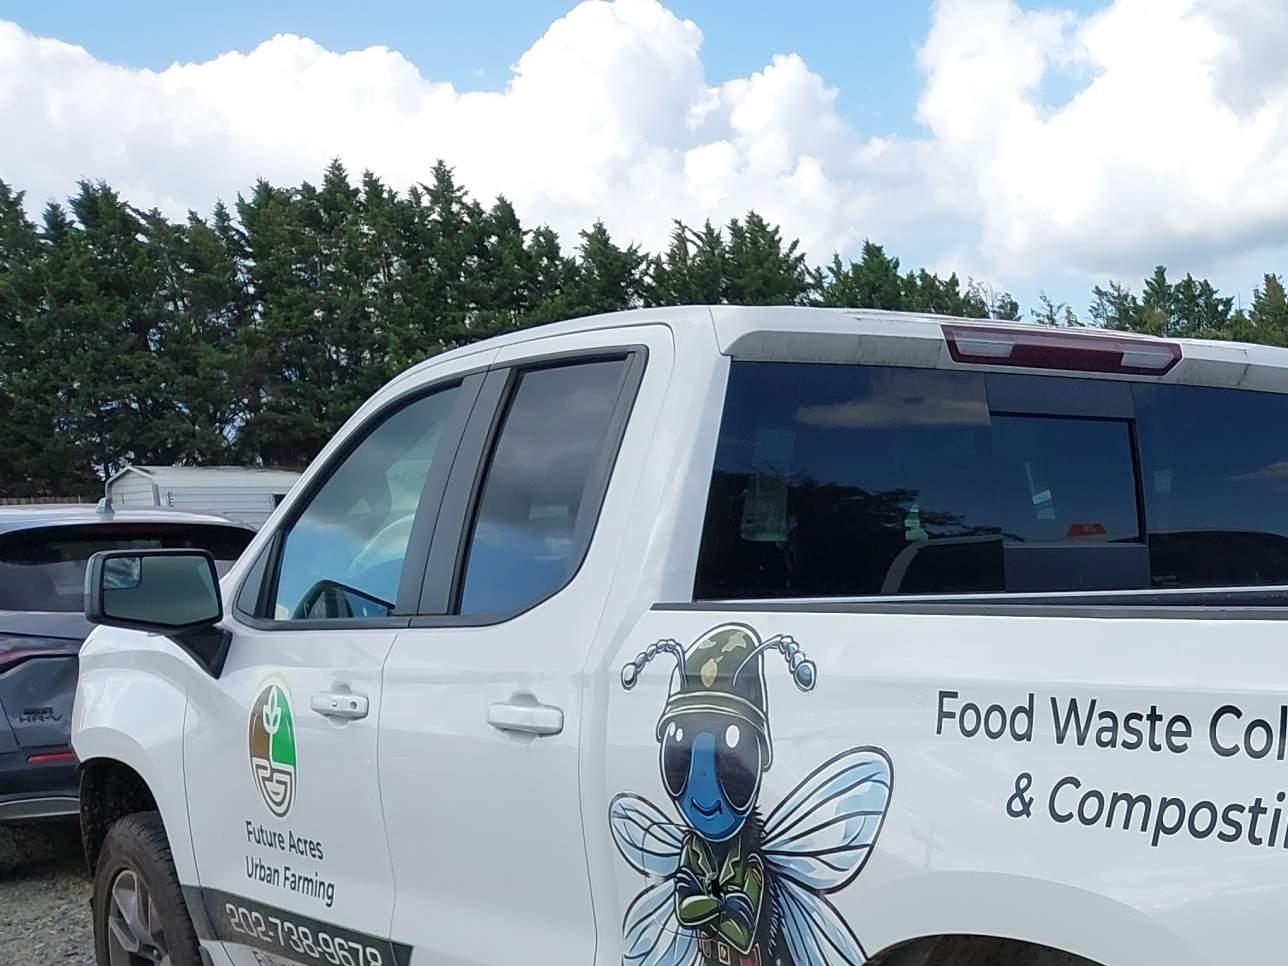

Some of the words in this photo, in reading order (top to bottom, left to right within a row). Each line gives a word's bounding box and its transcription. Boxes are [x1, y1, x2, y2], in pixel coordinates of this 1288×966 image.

[19, 713, 64, 723] HR-V
[936, 690, 1035, 742] Food
[1050, 696, 1193, 754] Waste
[1006, 772, 1035, 818] &
[245, 820, 286, 851] Future
[288, 830, 324, 860] Acres
[245, 855, 281, 888] Urban
[283, 866, 335, 908] Farming
